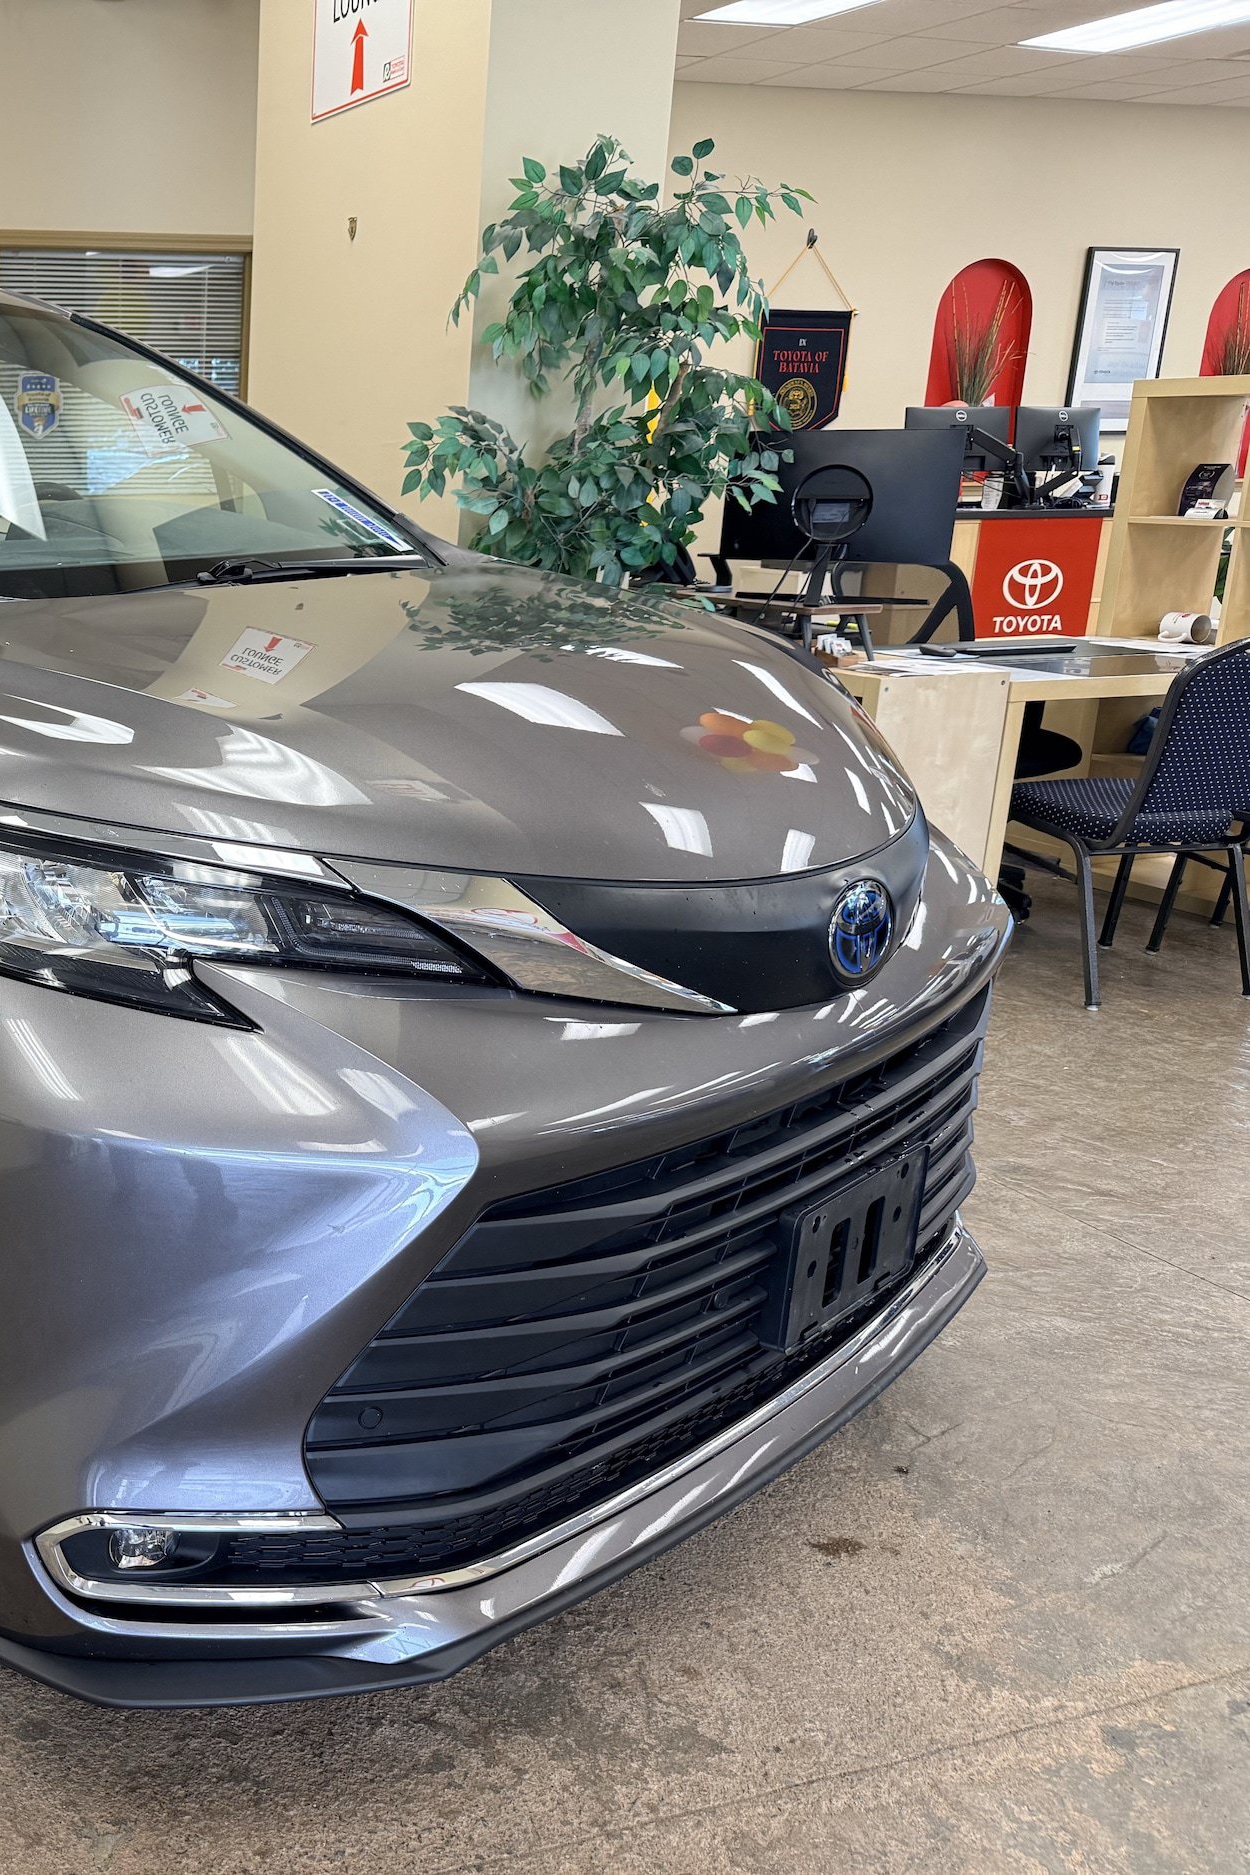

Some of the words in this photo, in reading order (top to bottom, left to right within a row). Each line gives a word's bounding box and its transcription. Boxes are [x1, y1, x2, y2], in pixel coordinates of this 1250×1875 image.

[773, 351, 812, 362] TOYOTA
[815, 351, 829, 362] OF
[778, 362, 820, 373] BATAVIA
[992, 614, 1063, 633] TOYOTA
